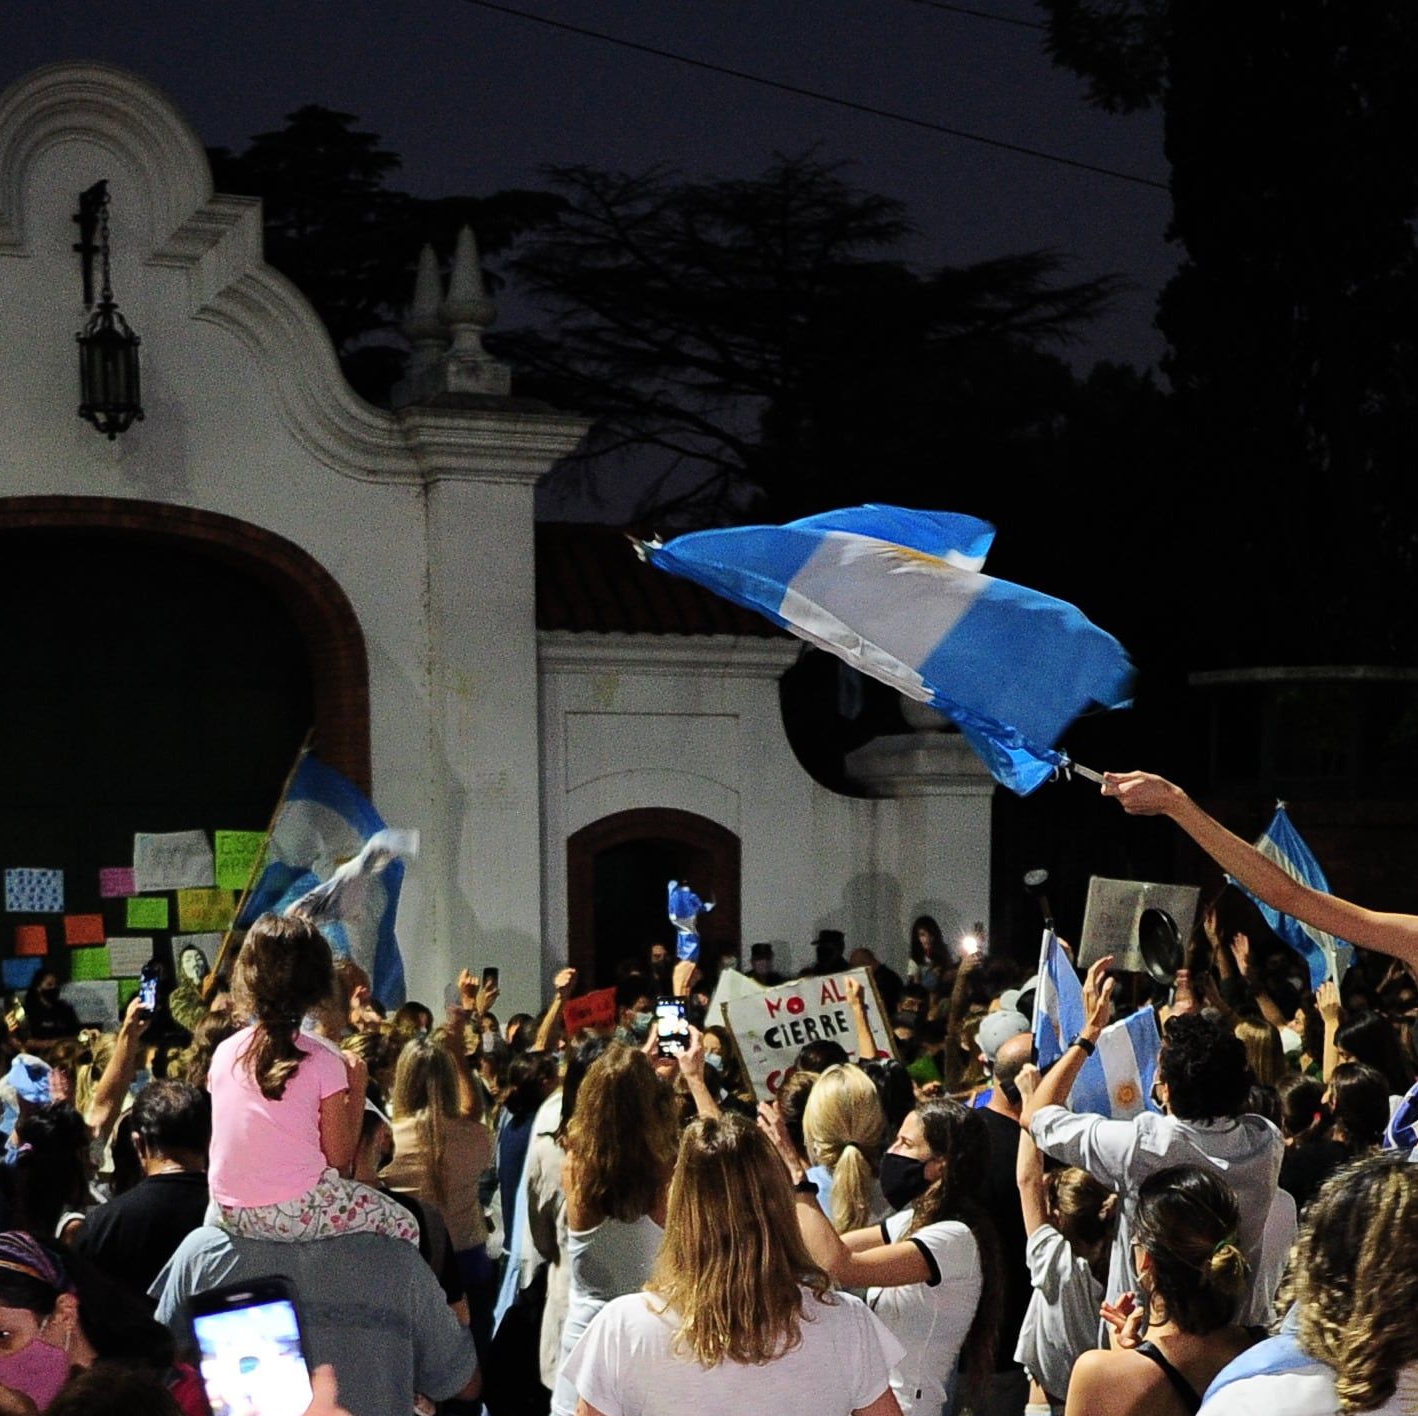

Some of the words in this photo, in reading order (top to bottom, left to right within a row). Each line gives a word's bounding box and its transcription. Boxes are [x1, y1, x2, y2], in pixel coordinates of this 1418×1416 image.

[764, 996, 805, 1018] NO
[820, 978, 847, 1005] AL
[764, 1011, 848, 1049] CIERRE
